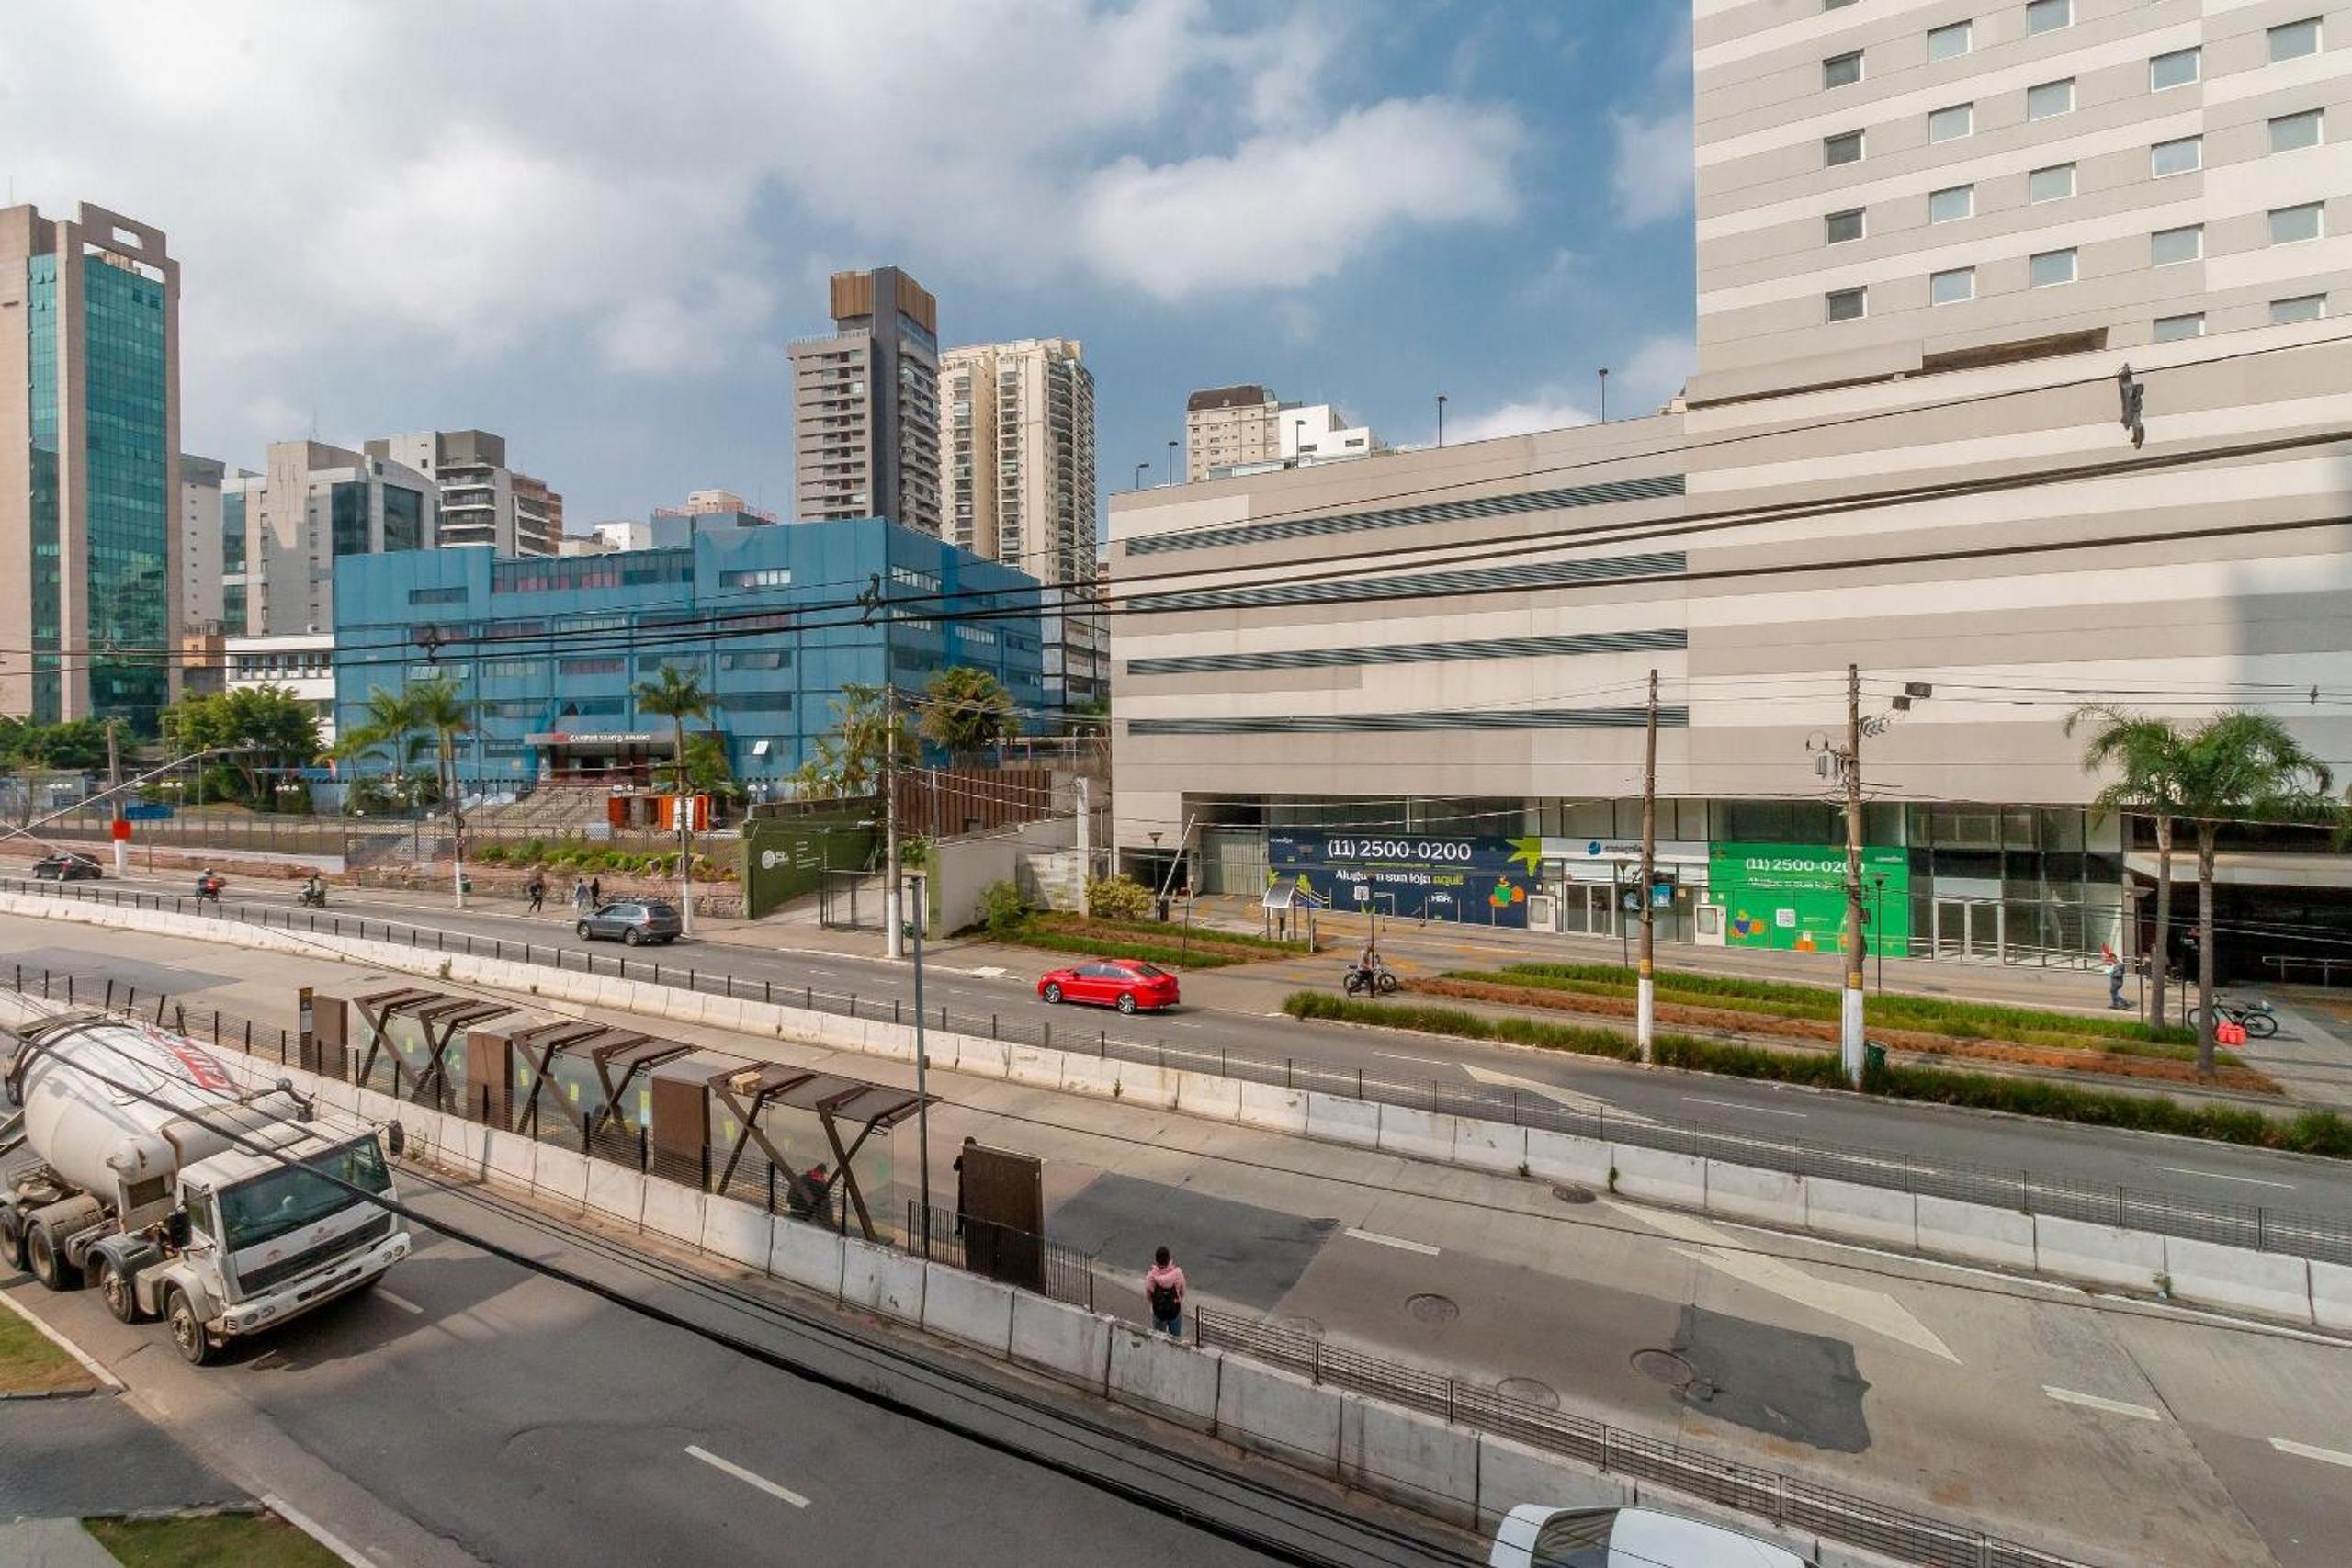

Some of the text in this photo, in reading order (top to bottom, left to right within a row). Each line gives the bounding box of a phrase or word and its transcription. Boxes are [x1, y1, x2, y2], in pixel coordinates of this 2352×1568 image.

[599, 734, 623, 742] SANTO
[1328, 840, 1472, 861] (11) 2500-0200
[1746, 857, 1770, 872] (11)
